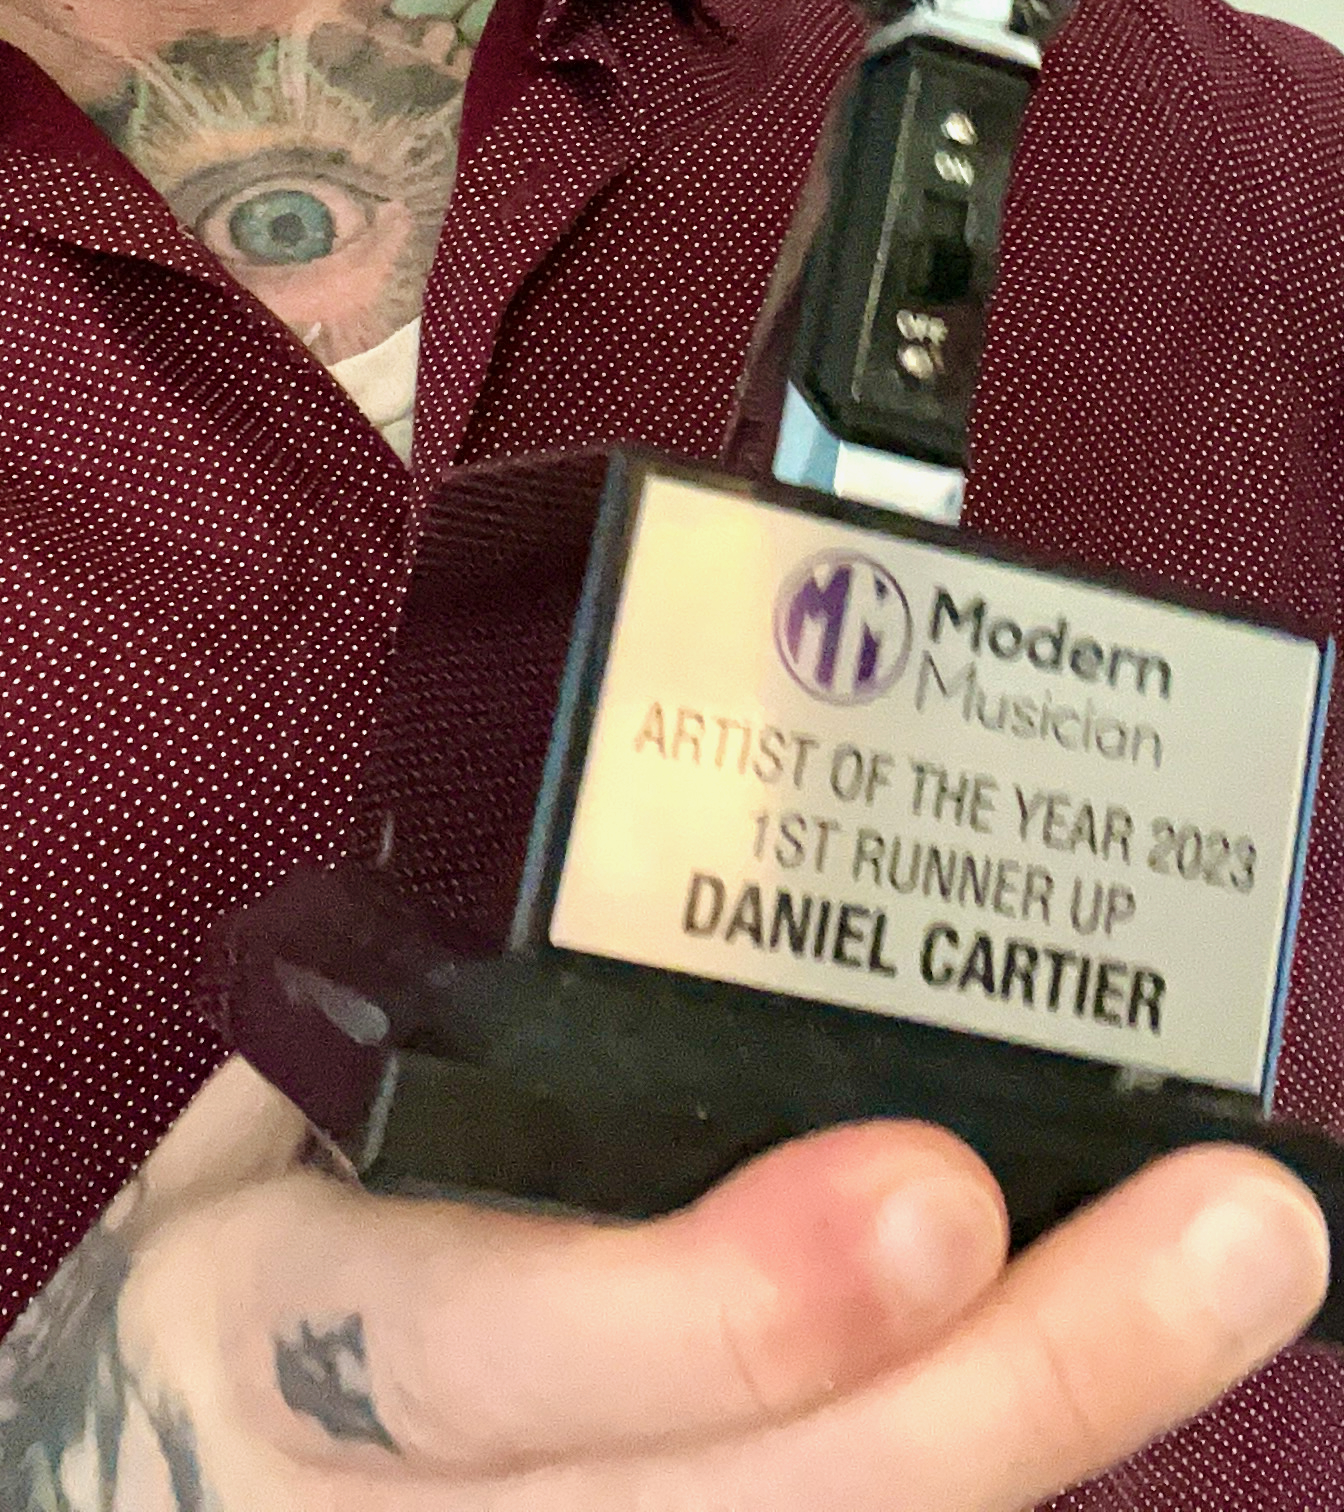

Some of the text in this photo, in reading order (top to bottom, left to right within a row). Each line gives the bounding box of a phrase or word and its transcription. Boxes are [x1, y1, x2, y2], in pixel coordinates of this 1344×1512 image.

[928, 586, 1172, 703] Modern
[914, 649, 1164, 768] Musician
[634, 700, 1258, 893] ARTIST OF THE YEAR 2023
[754, 810, 1138, 935] 1ST RUNNER UP
[681, 869, 1168, 1036] DANIEL CARTIER
